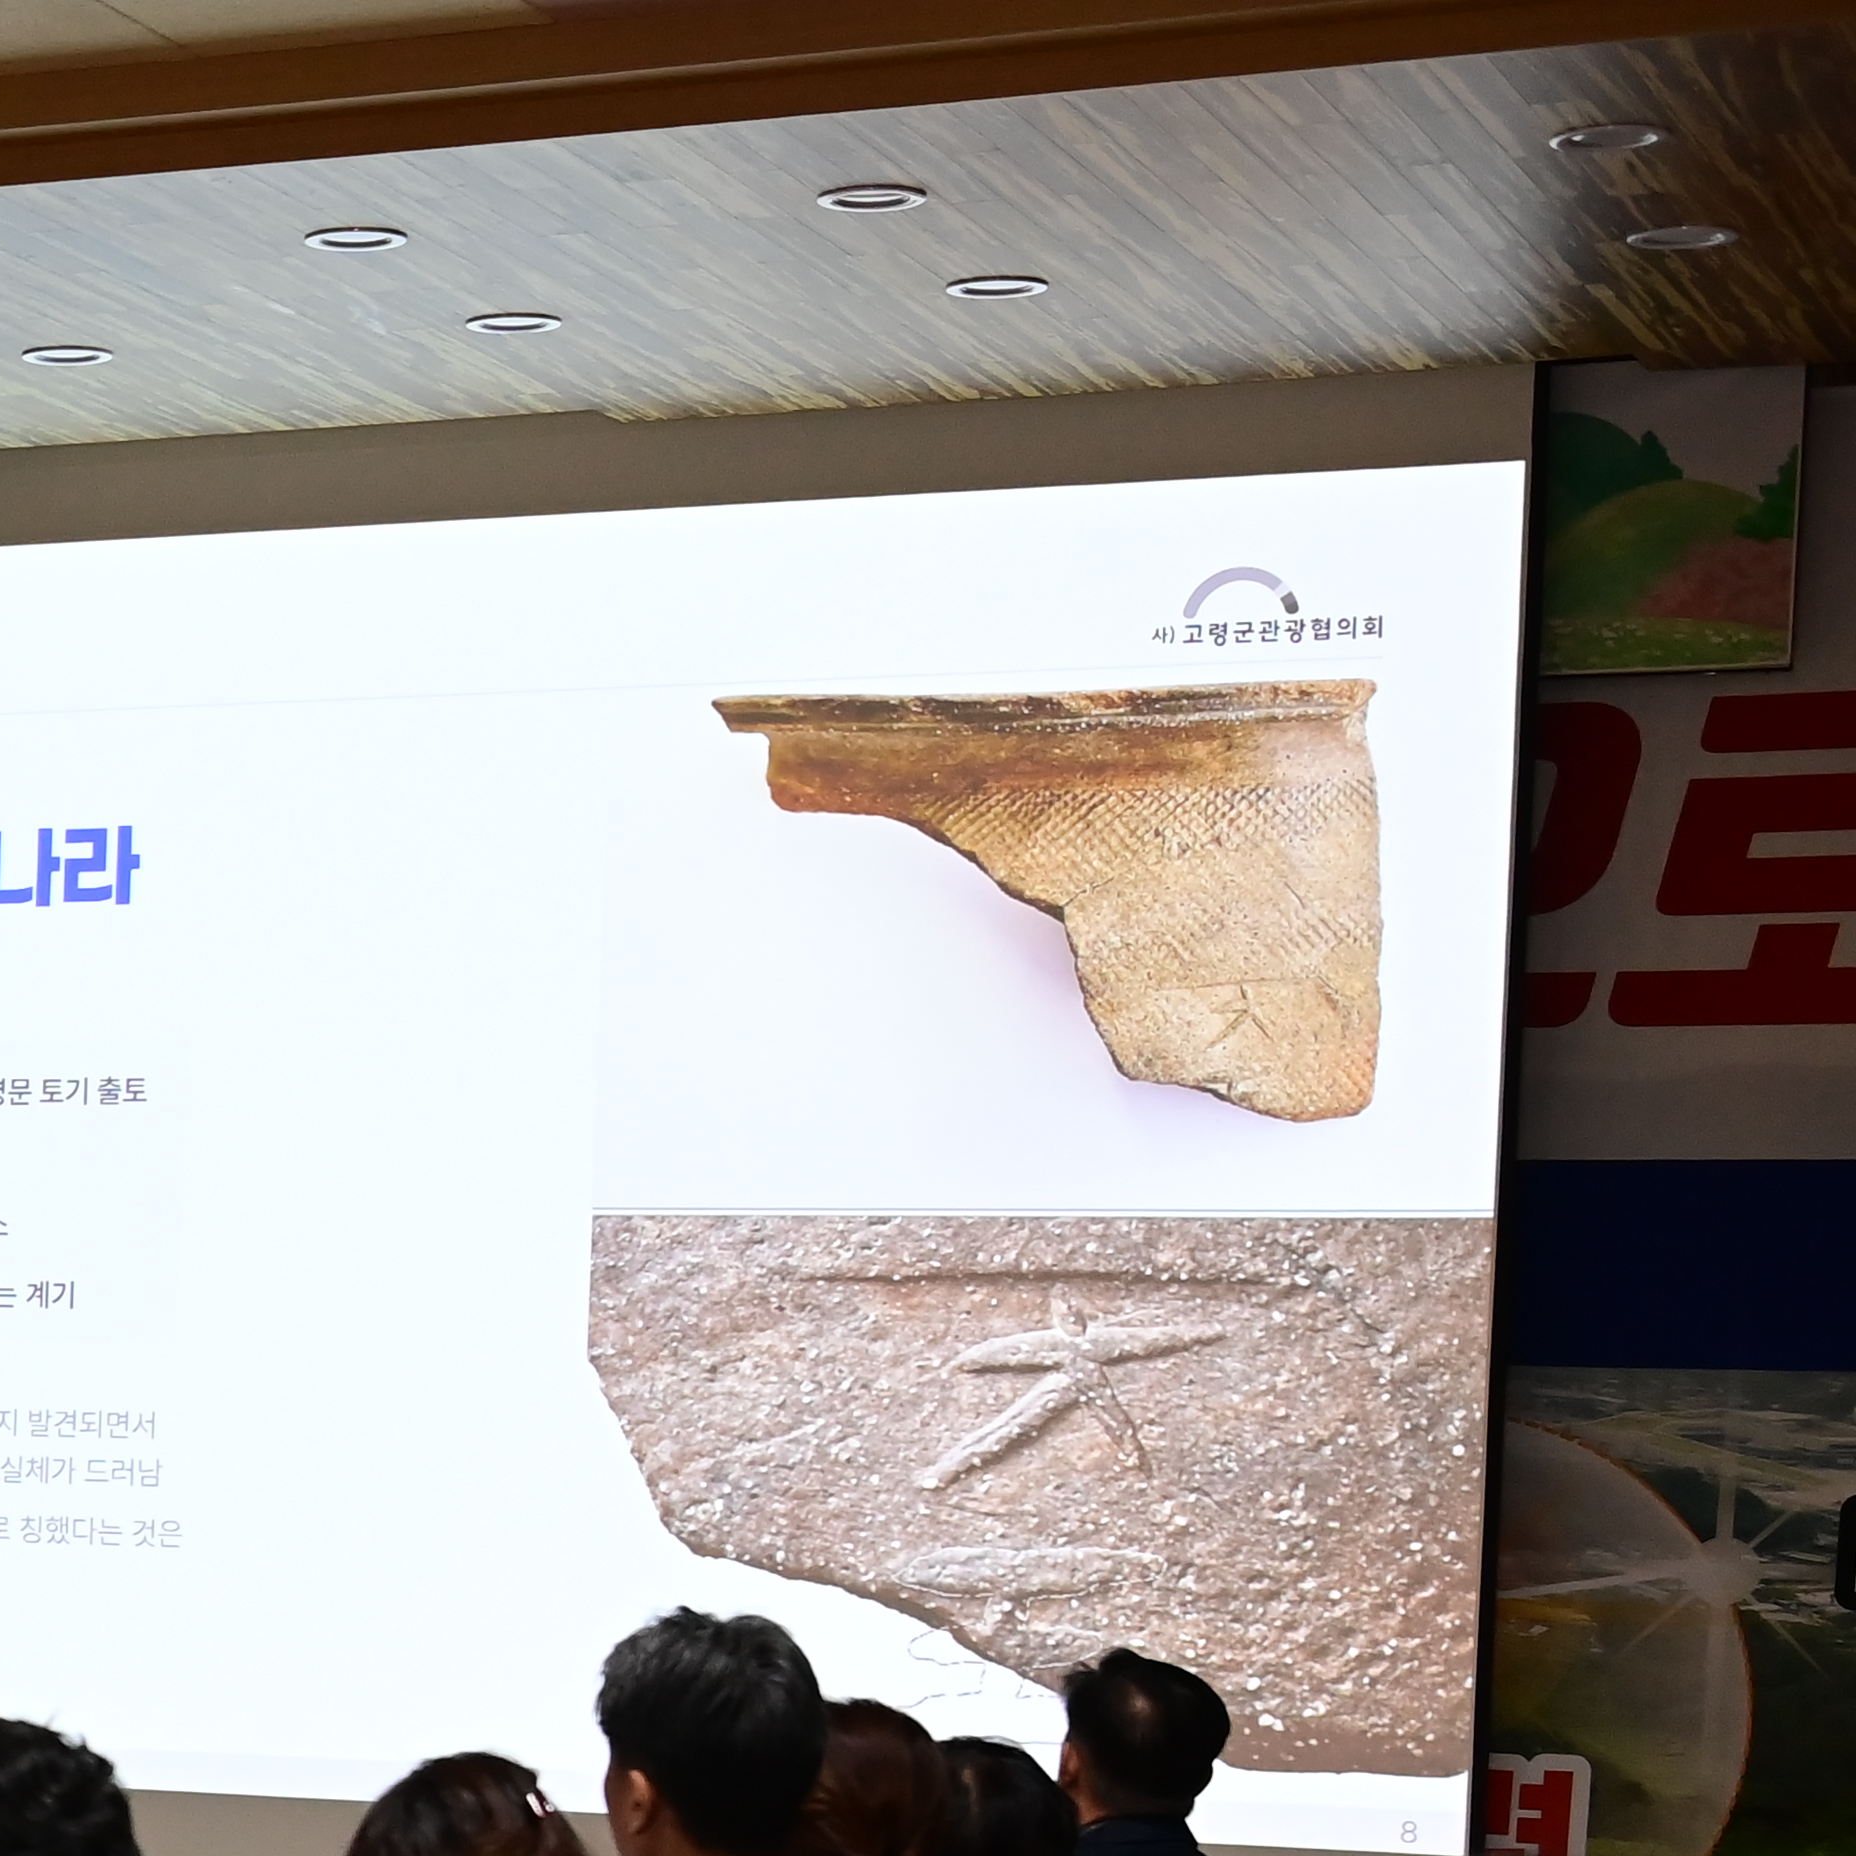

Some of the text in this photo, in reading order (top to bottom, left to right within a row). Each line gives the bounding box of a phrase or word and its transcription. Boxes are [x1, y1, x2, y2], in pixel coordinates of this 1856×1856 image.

[39, 1076, 89, 1106] 토기
[97, 1075, 148, 1106] 출토
[25, 1280, 75, 1310] 계기
[28, 1408, 156, 1440] 발견되면서
[0, 1455, 77, 1485] 실체가
[83, 1458, 163, 1488] 드러남
[19, 1515, 123, 1547] 칭했다는
[132, 1518, 183, 1549] 것은
[1399, 1820, 1418, 1844] 8
